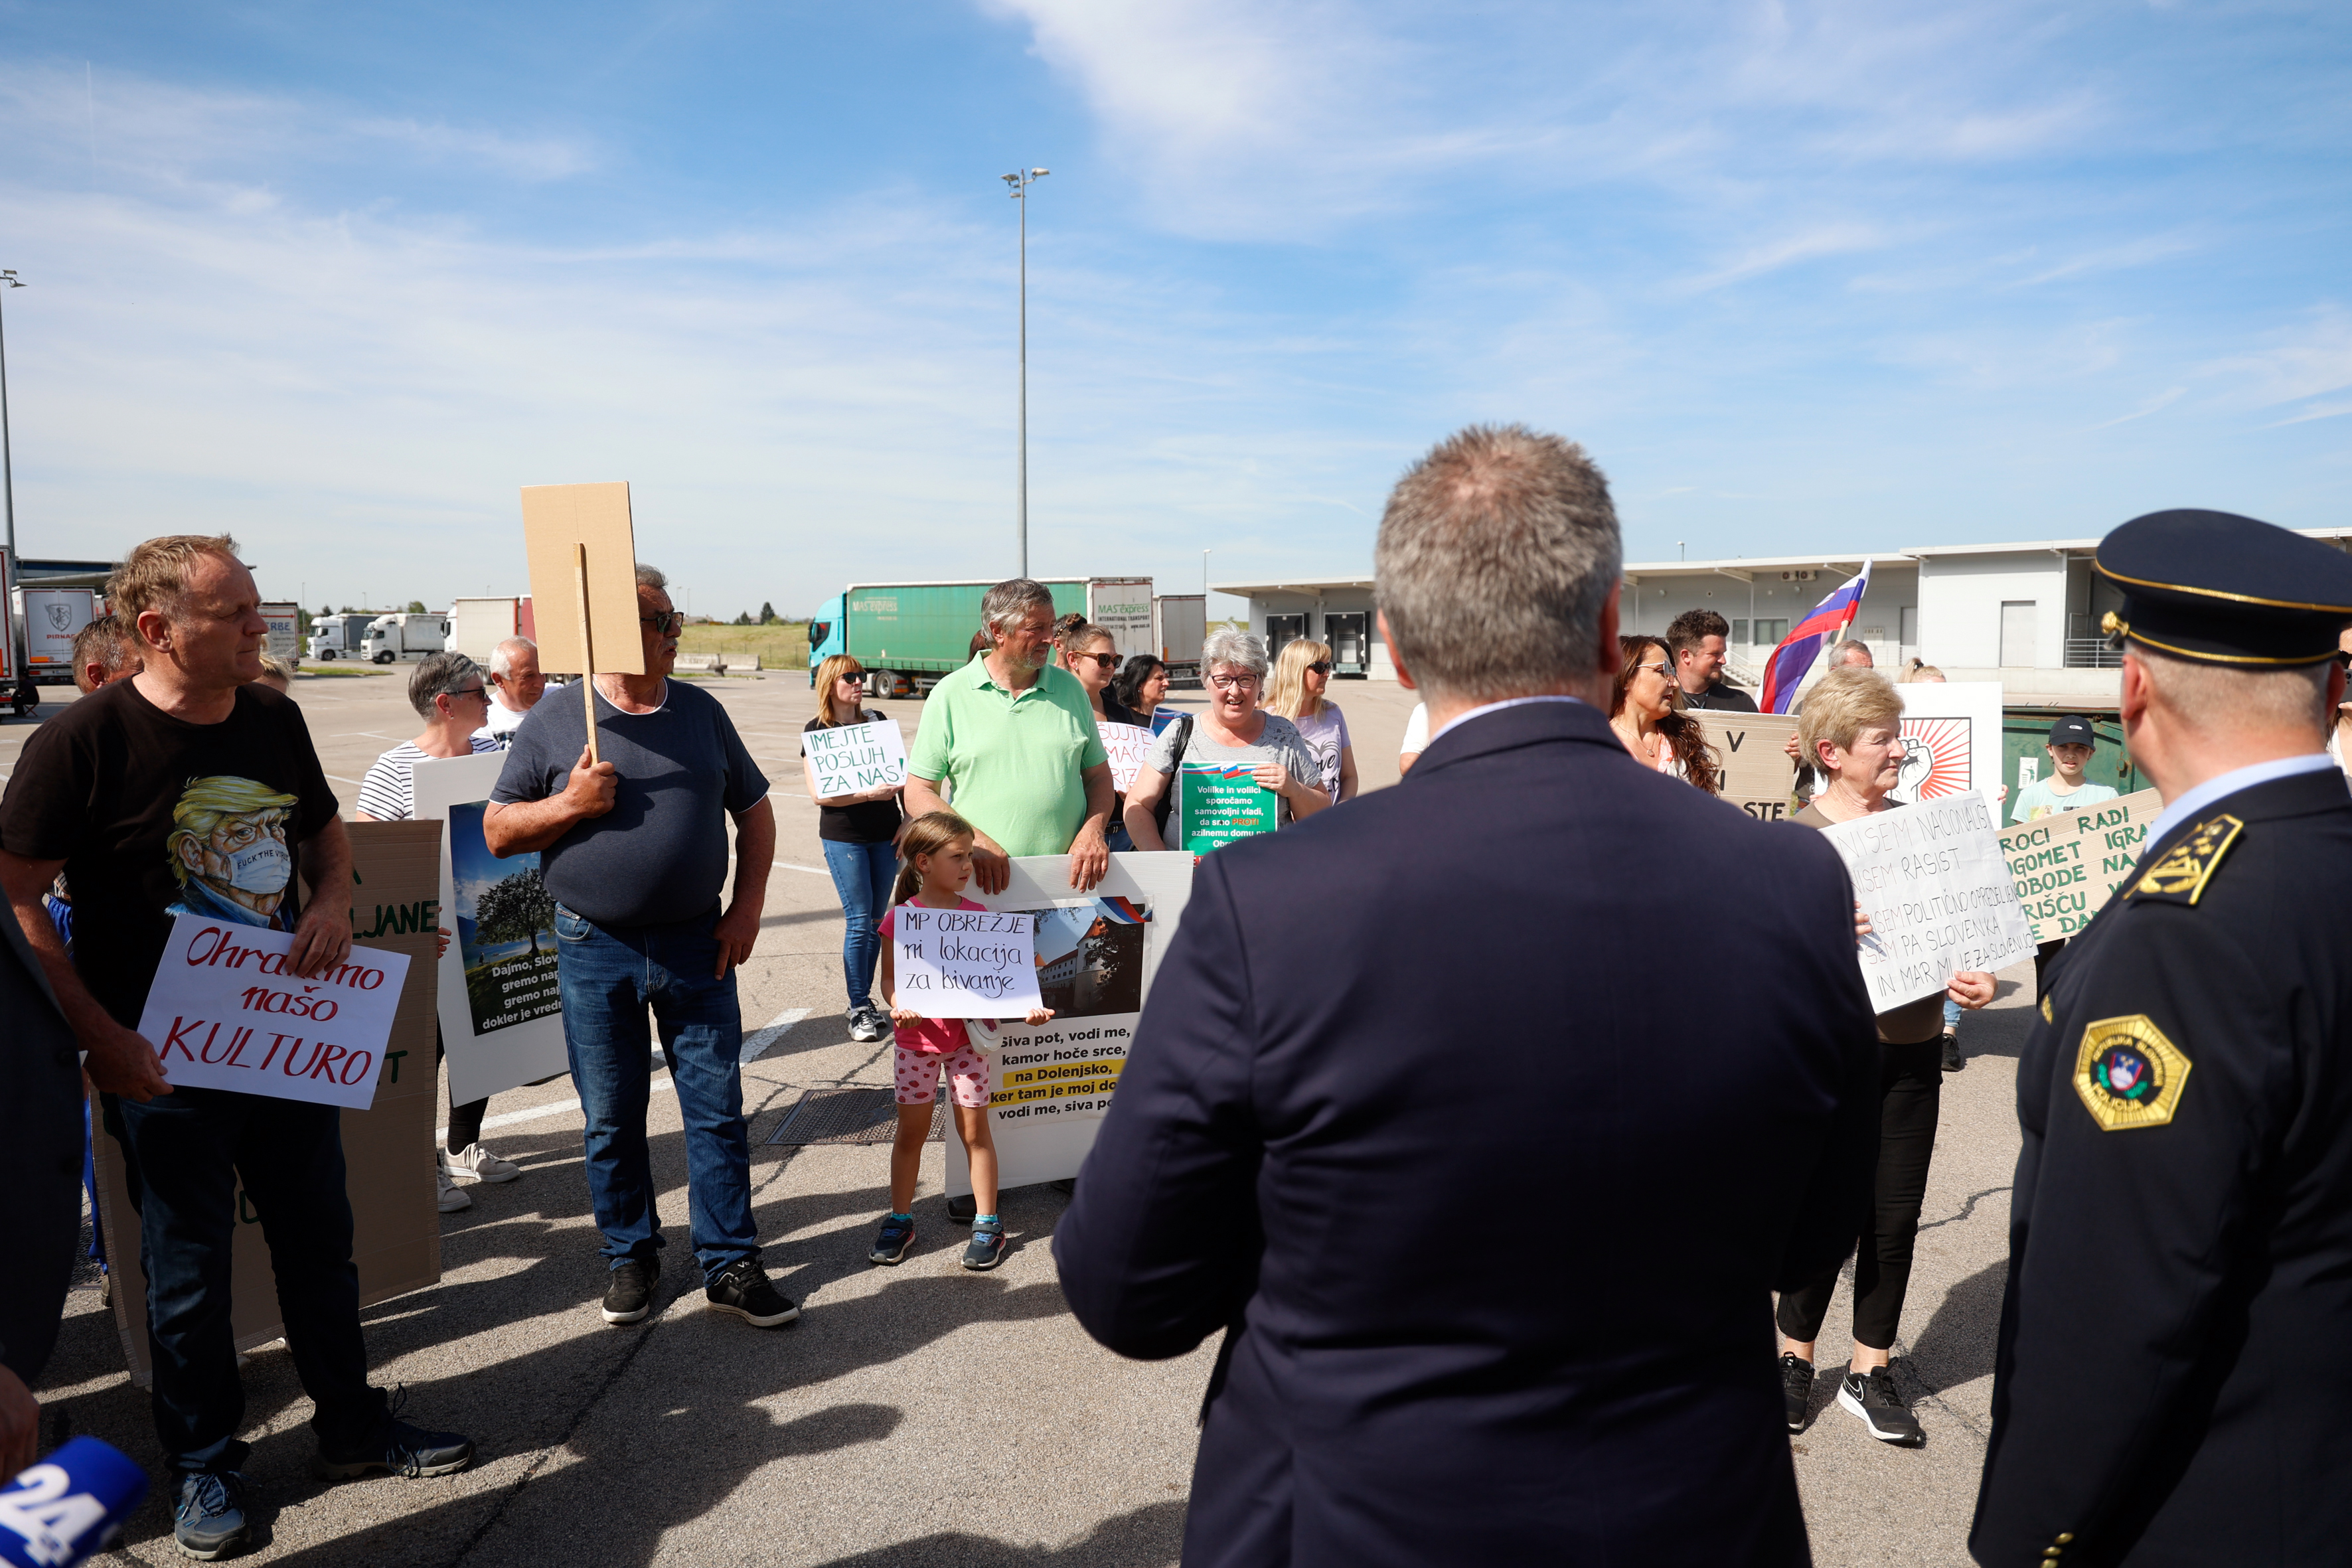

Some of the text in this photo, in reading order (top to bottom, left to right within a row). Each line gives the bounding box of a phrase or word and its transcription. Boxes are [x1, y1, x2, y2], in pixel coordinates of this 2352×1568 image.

[1098, 605, 1149, 615] MAS express
[266, 622, 290, 631] RBE
[810, 725, 874, 751] IMEJTE
[1726, 730, 1745, 752] V
[813, 746, 886, 773] POSLUH
[820, 757, 905, 793] ZA NAS!
[1197, 785, 1225, 794] Volilke
[1194, 807, 1264, 817] samovoljni vladi,
[1206, 797, 1253, 805] sporočamo
[2077, 806, 2129, 834] RADI
[1837, 819, 1913, 860] NISEM
[2104, 821, 2151, 850] IGRA
[237, 854, 258, 870] FUCK
[258, 850, 274, 859] THE
[1901, 848, 1960, 881] RASIST
[1903, 888, 1969, 926] POLITIČNO
[905, 912, 1027, 934] MP OBREŽJE
[1865, 915, 2001, 965] SEM PA SLOVENKA
[903, 936, 1023, 971] ni lokacija
[492, 961, 532, 977] Dajmo,
[1877, 932, 2034, 998] IN MAR MI JE ZA SLOVENIJO
[501, 975, 538, 993] gremo
[905, 965, 1015, 998] za bivanje
[240, 985, 339, 1022] našo
[504, 991, 540, 1009] gremo
[483, 1012, 518, 1030] dokler
[520, 1009, 531, 1021] je
[1000, 1028, 1131, 1048] Siva pot, vodi me,
[159, 1016, 372, 1085] KULTURO
[1002, 1046, 1127, 1066] kamor hoče srce,
[1015, 1063, 1113, 1083] na Dolenjsko,
[990, 1092, 1014, 1103] ker
[1018, 1087, 1046, 1100] tam
[1050, 1085, 1063, 1099] je
[1067, 1081, 1095, 1095] moj
[998, 1106, 1030, 1120] vodi
[1034, 1103, 1061, 1116] me,
[1065, 1100, 1093, 1112] siva
